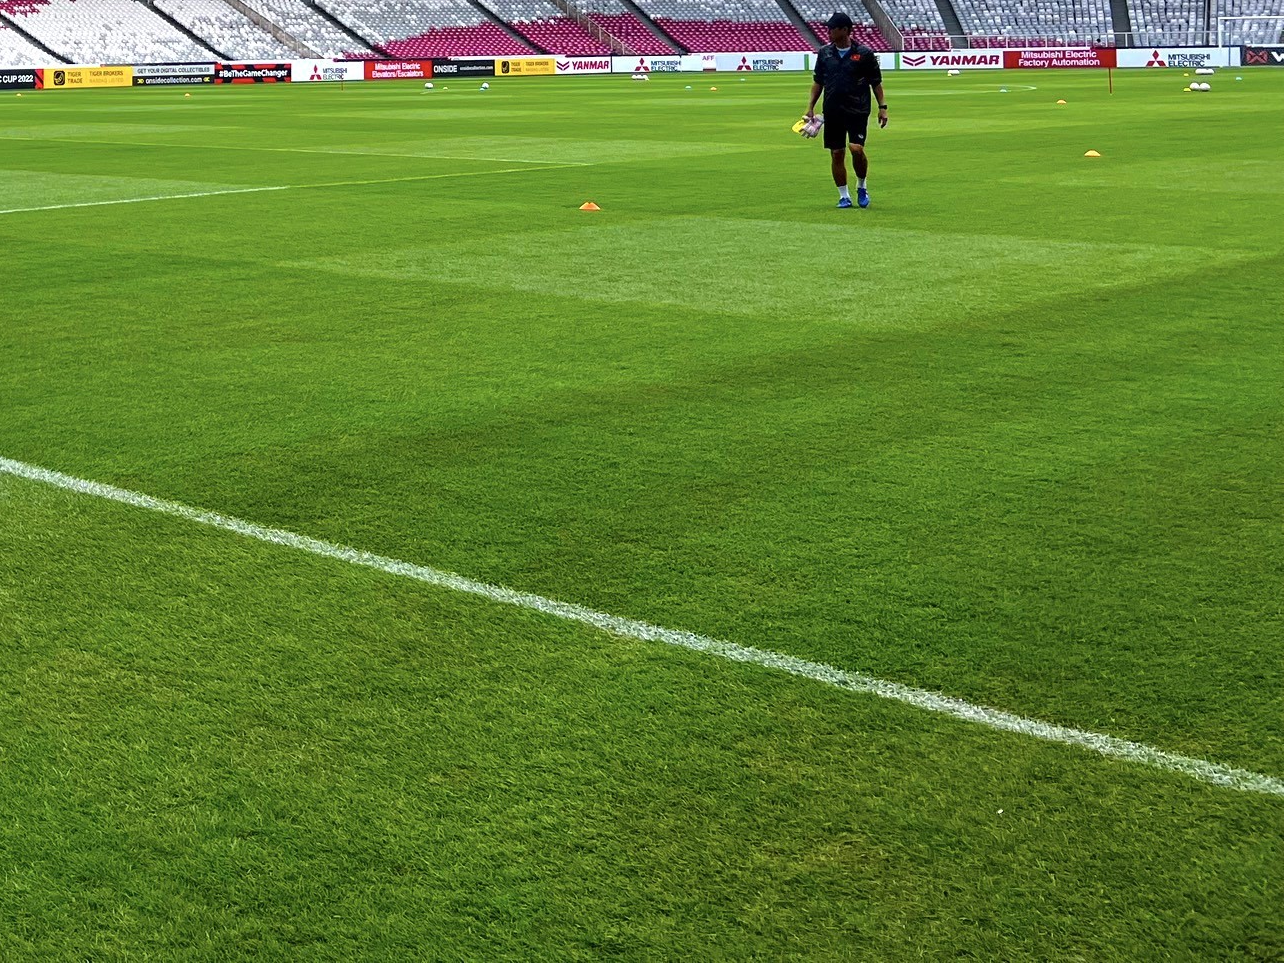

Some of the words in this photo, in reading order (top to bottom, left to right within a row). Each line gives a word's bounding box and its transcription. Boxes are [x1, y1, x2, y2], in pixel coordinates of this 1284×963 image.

[1021, 51, 1063, 59] Mitsubishi
[1065, 50, 1097, 58] Electric
[1168, 53, 1210, 61] MITSUBISHI
[930, 55, 1000, 65] YANMAR
[1018, 59, 1049, 67] Factory
[1051, 58, 1100, 66] Automation
[433, 65, 457, 73] ONSIDE
[572, 60, 610, 70] YANMAR
[219, 69, 288, 78] #BeTheGameChanger
[3, 75, 17, 83] CUP
[17, 74, 34, 83] 2022
[145, 76, 203, 84] onsidecollection.com
